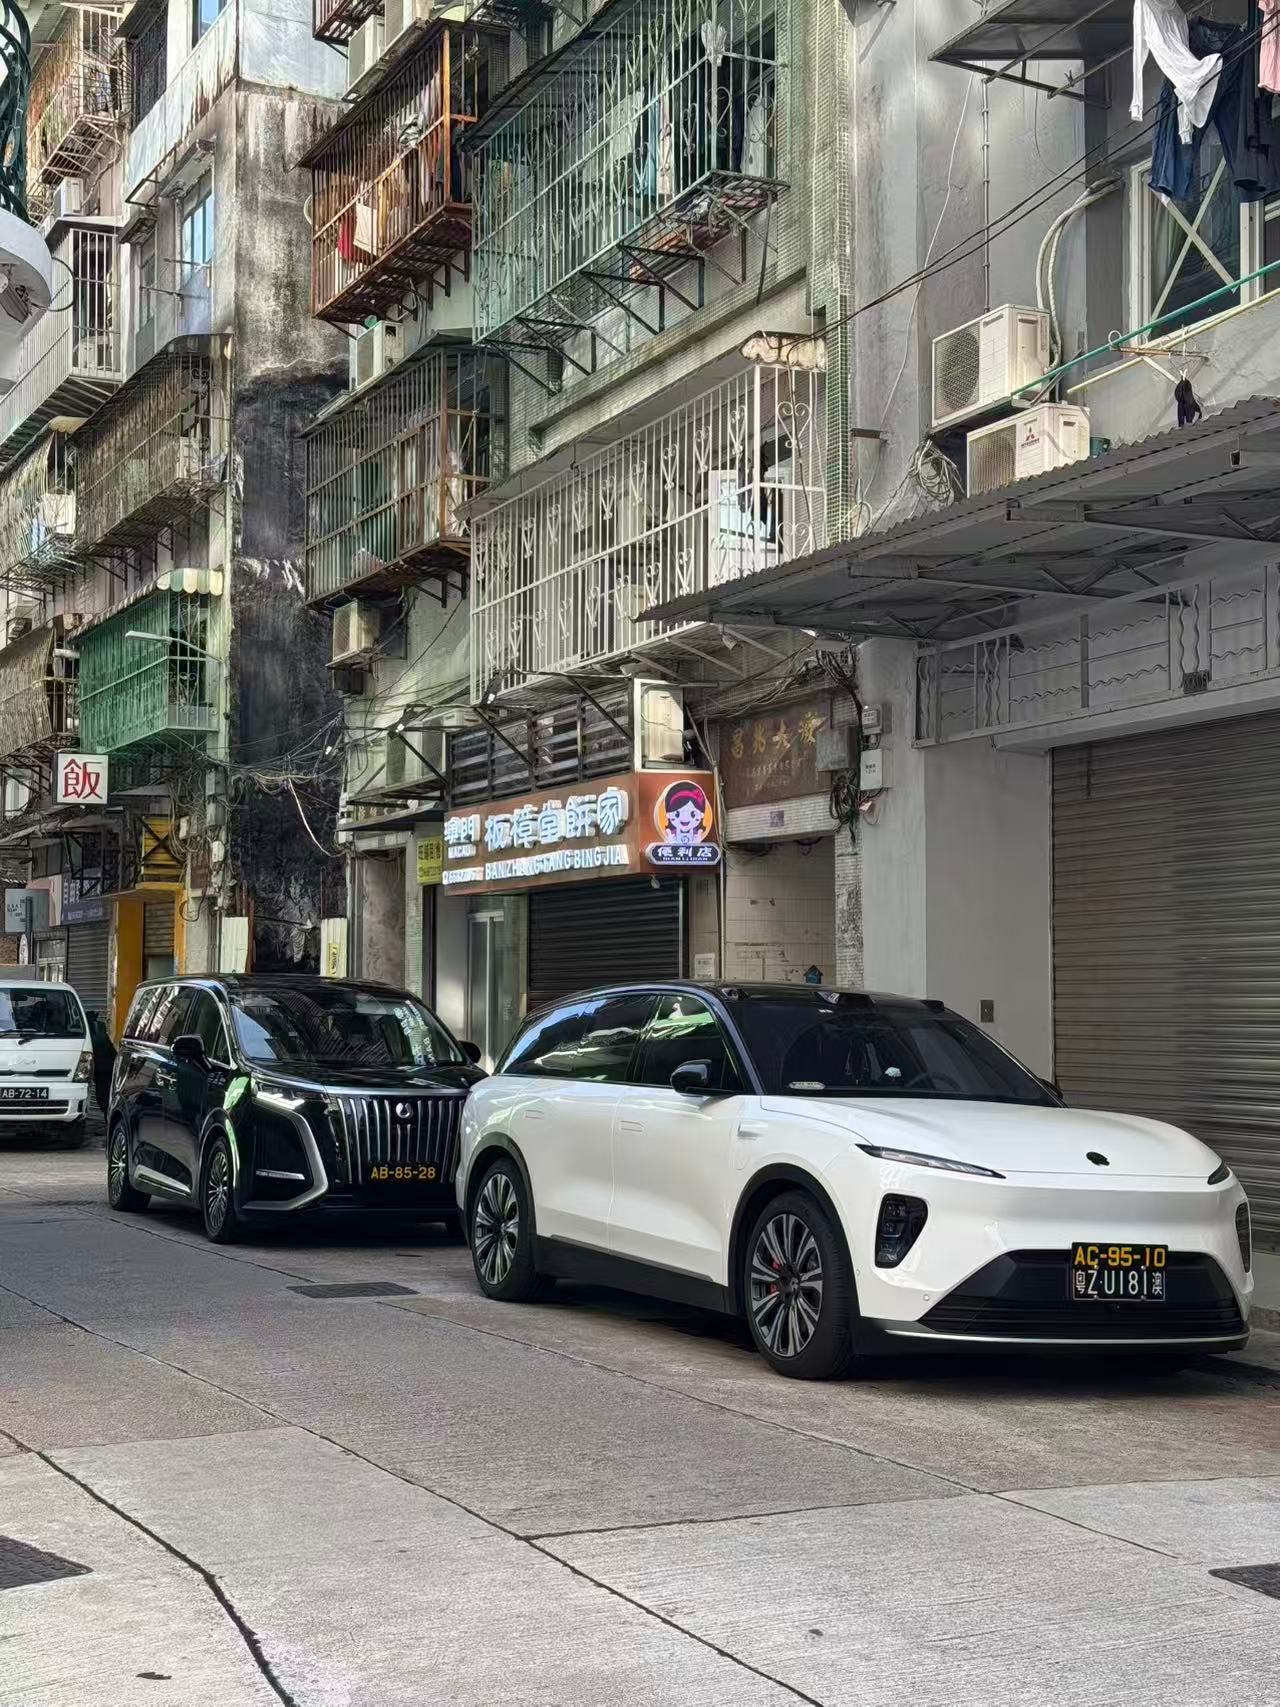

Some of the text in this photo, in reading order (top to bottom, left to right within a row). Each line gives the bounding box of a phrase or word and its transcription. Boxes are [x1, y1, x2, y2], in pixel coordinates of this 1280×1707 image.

[63, 758, 103, 799] 飯
[444, 814, 480, 844] 澳門
[484, 786, 630, 851] 板樟堂餅家
[657, 846, 713, 857] 便利店
[2, 1088, 47, 1098] AB-72-14
[371, 1166, 436, 1179] AB-85-28
[1074, 1245, 1166, 1267] AC-95-10
